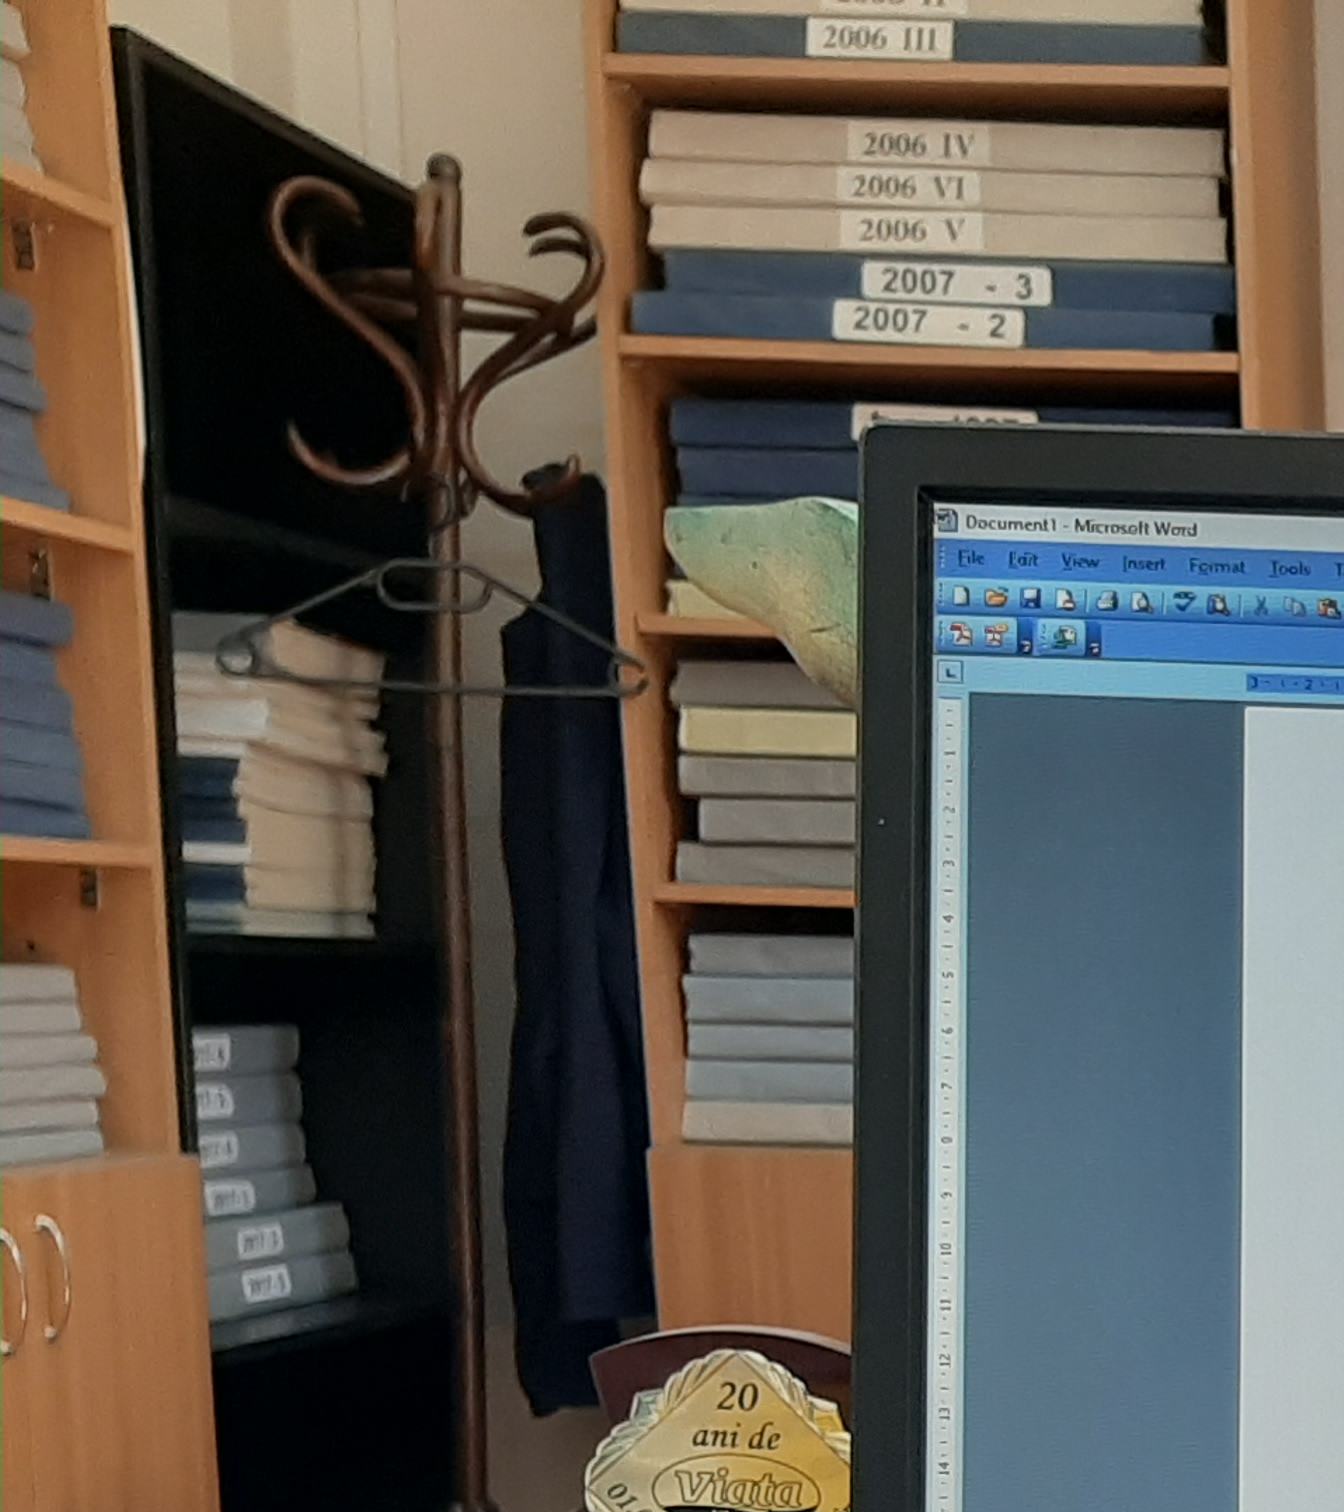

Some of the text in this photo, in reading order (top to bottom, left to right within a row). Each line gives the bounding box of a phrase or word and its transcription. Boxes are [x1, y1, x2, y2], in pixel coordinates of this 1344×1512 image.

[823, 25, 936, 51] 2006 III
[862, 132, 975, 160] 2006 IV
[851, 175, 966, 201] 2006 VI
[857, 218, 966, 243] 2006 V
[881, 268, 1034, 300] 2007 3
[853, 306, 1006, 339] 2007 2
[965, 514, 1198, 538] Document1 Microsoft Word
[958, 550, 985, 567] File
[1009, 551, 1039, 569] Edit
[1062, 553, 1100, 571] View
[1122, 555, 1165, 573] Insert
[1189, 557, 1246, 575] Format
[1271, 560, 1311, 578] Tools
[717, 1382, 759, 1411] 20
[692, 1422, 781, 1450] ani de
